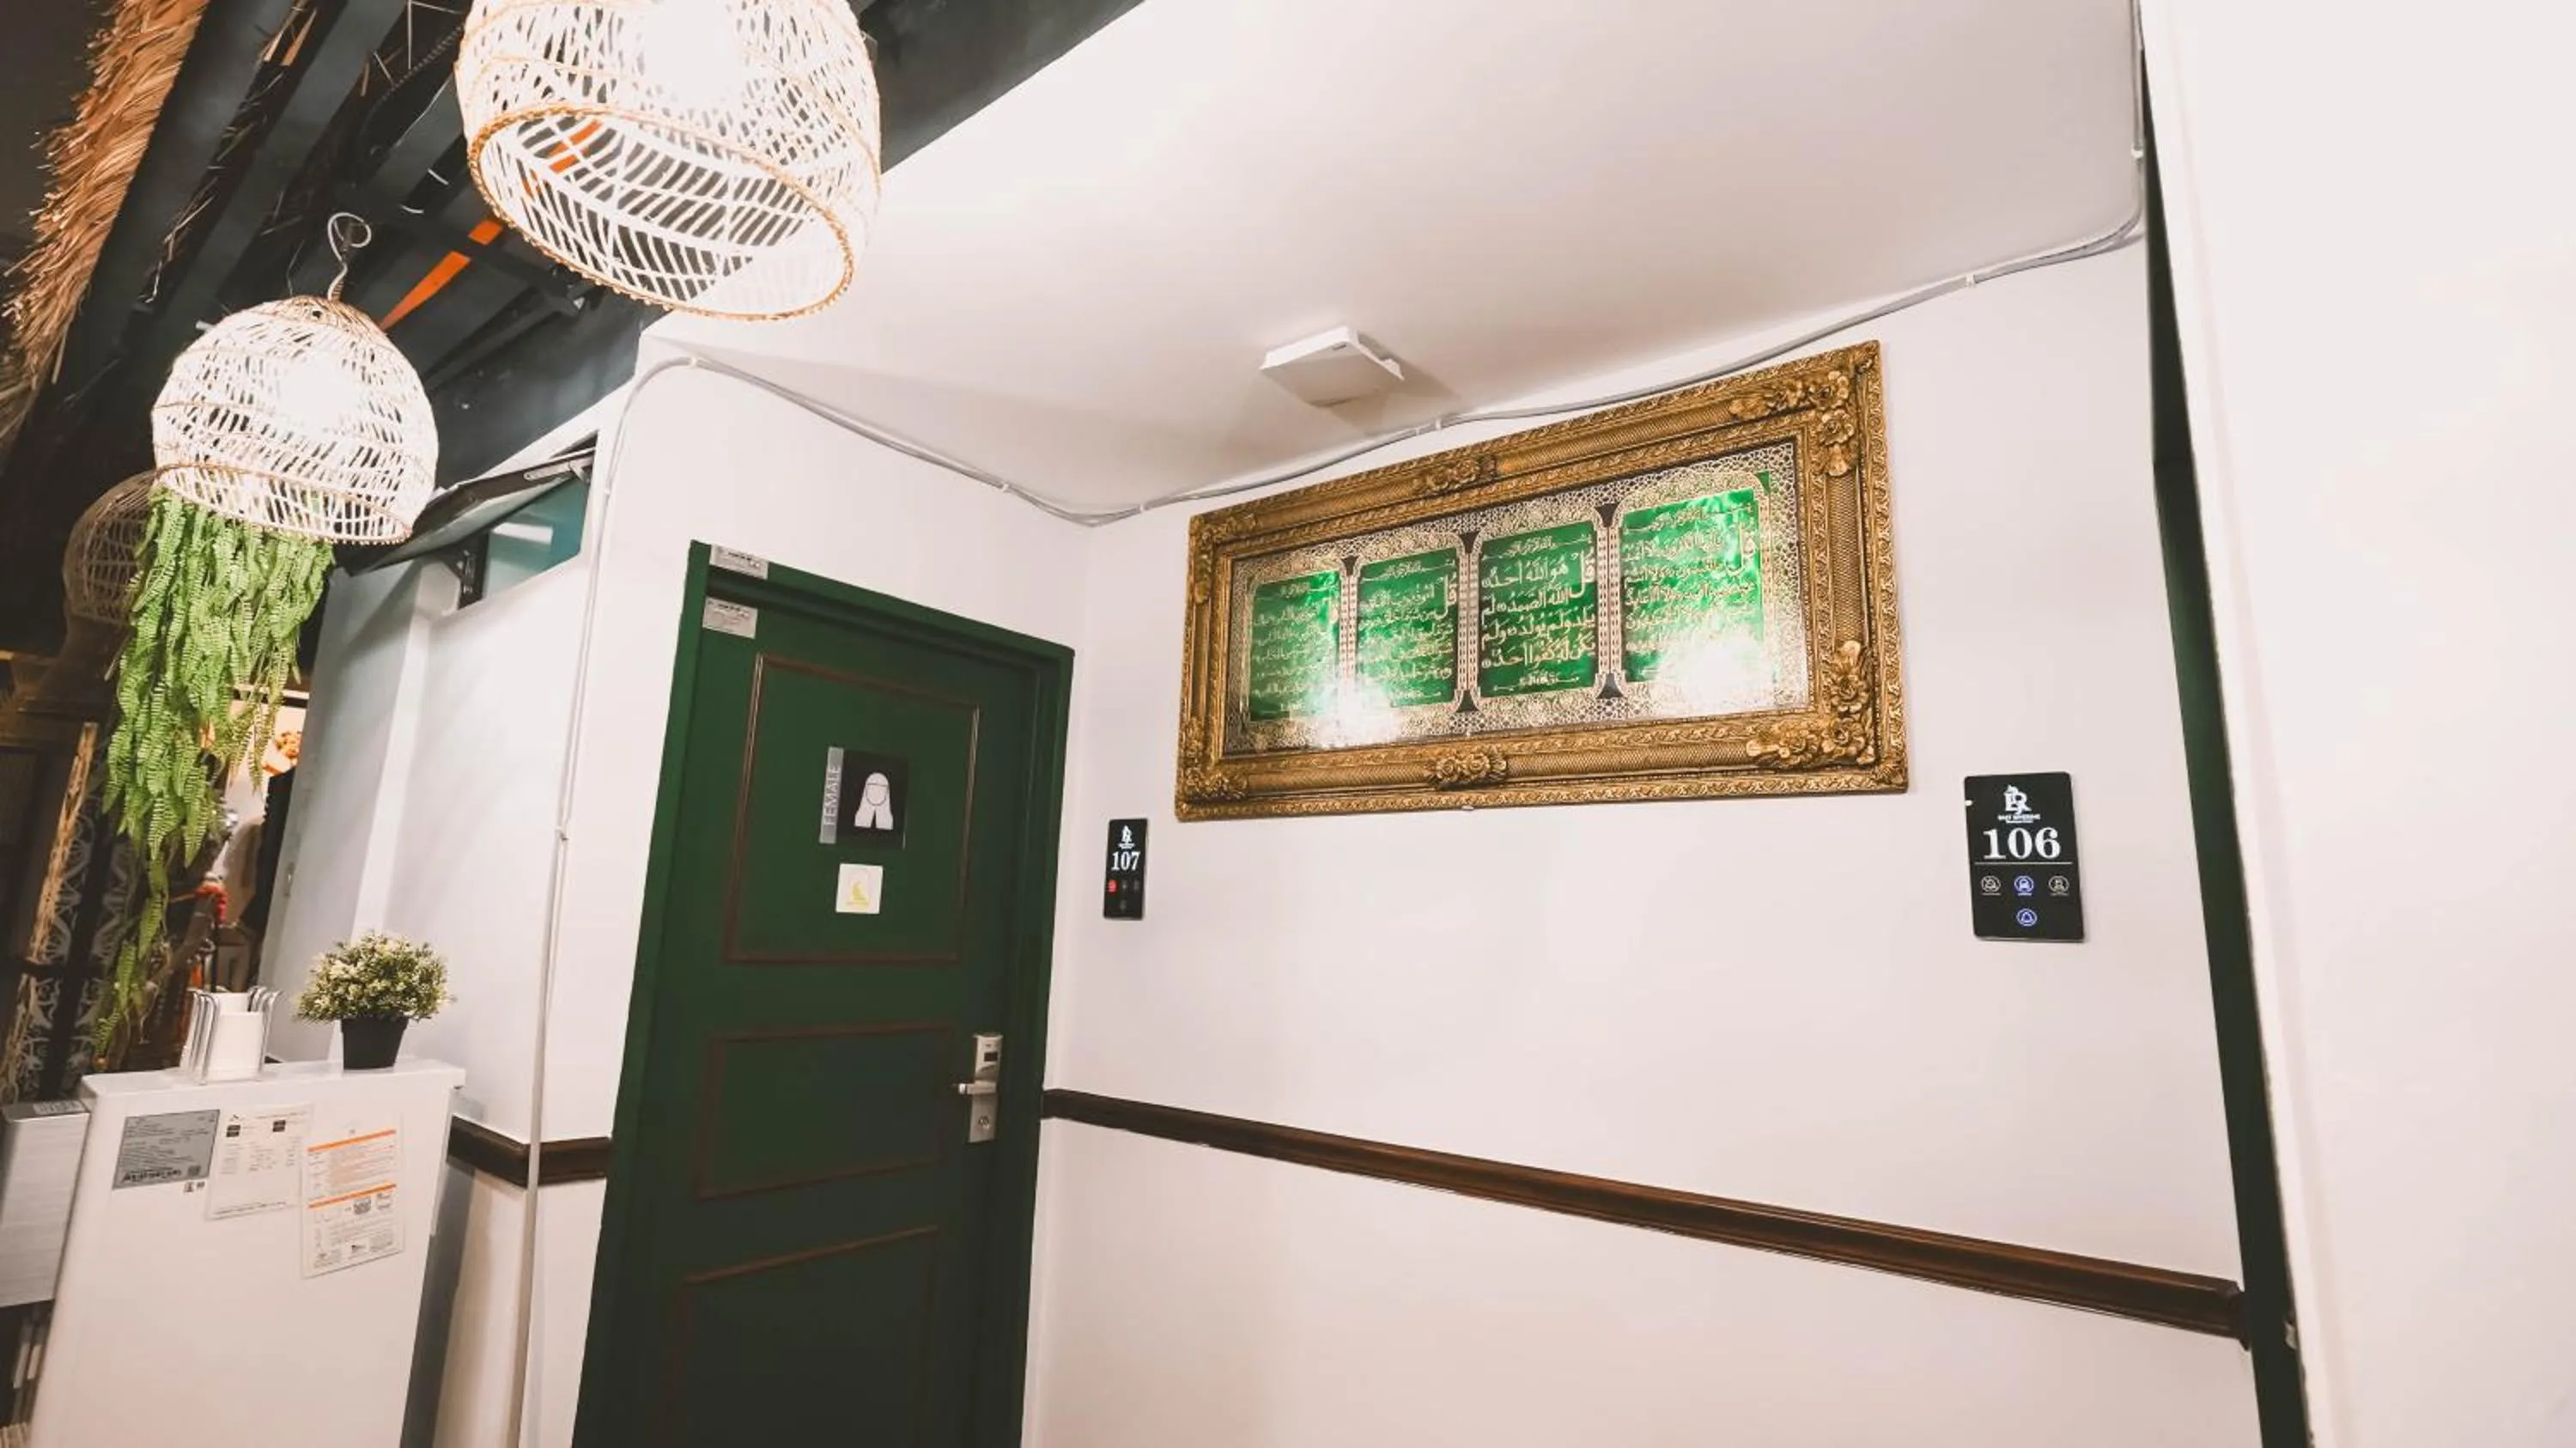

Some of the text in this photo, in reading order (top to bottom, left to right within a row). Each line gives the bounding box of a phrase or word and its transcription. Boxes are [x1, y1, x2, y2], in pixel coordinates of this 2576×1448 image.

[823, 765, 841, 825] FEMALE
[1983, 826, 2061, 860] 106
[1111, 850, 1141, 871] 107
